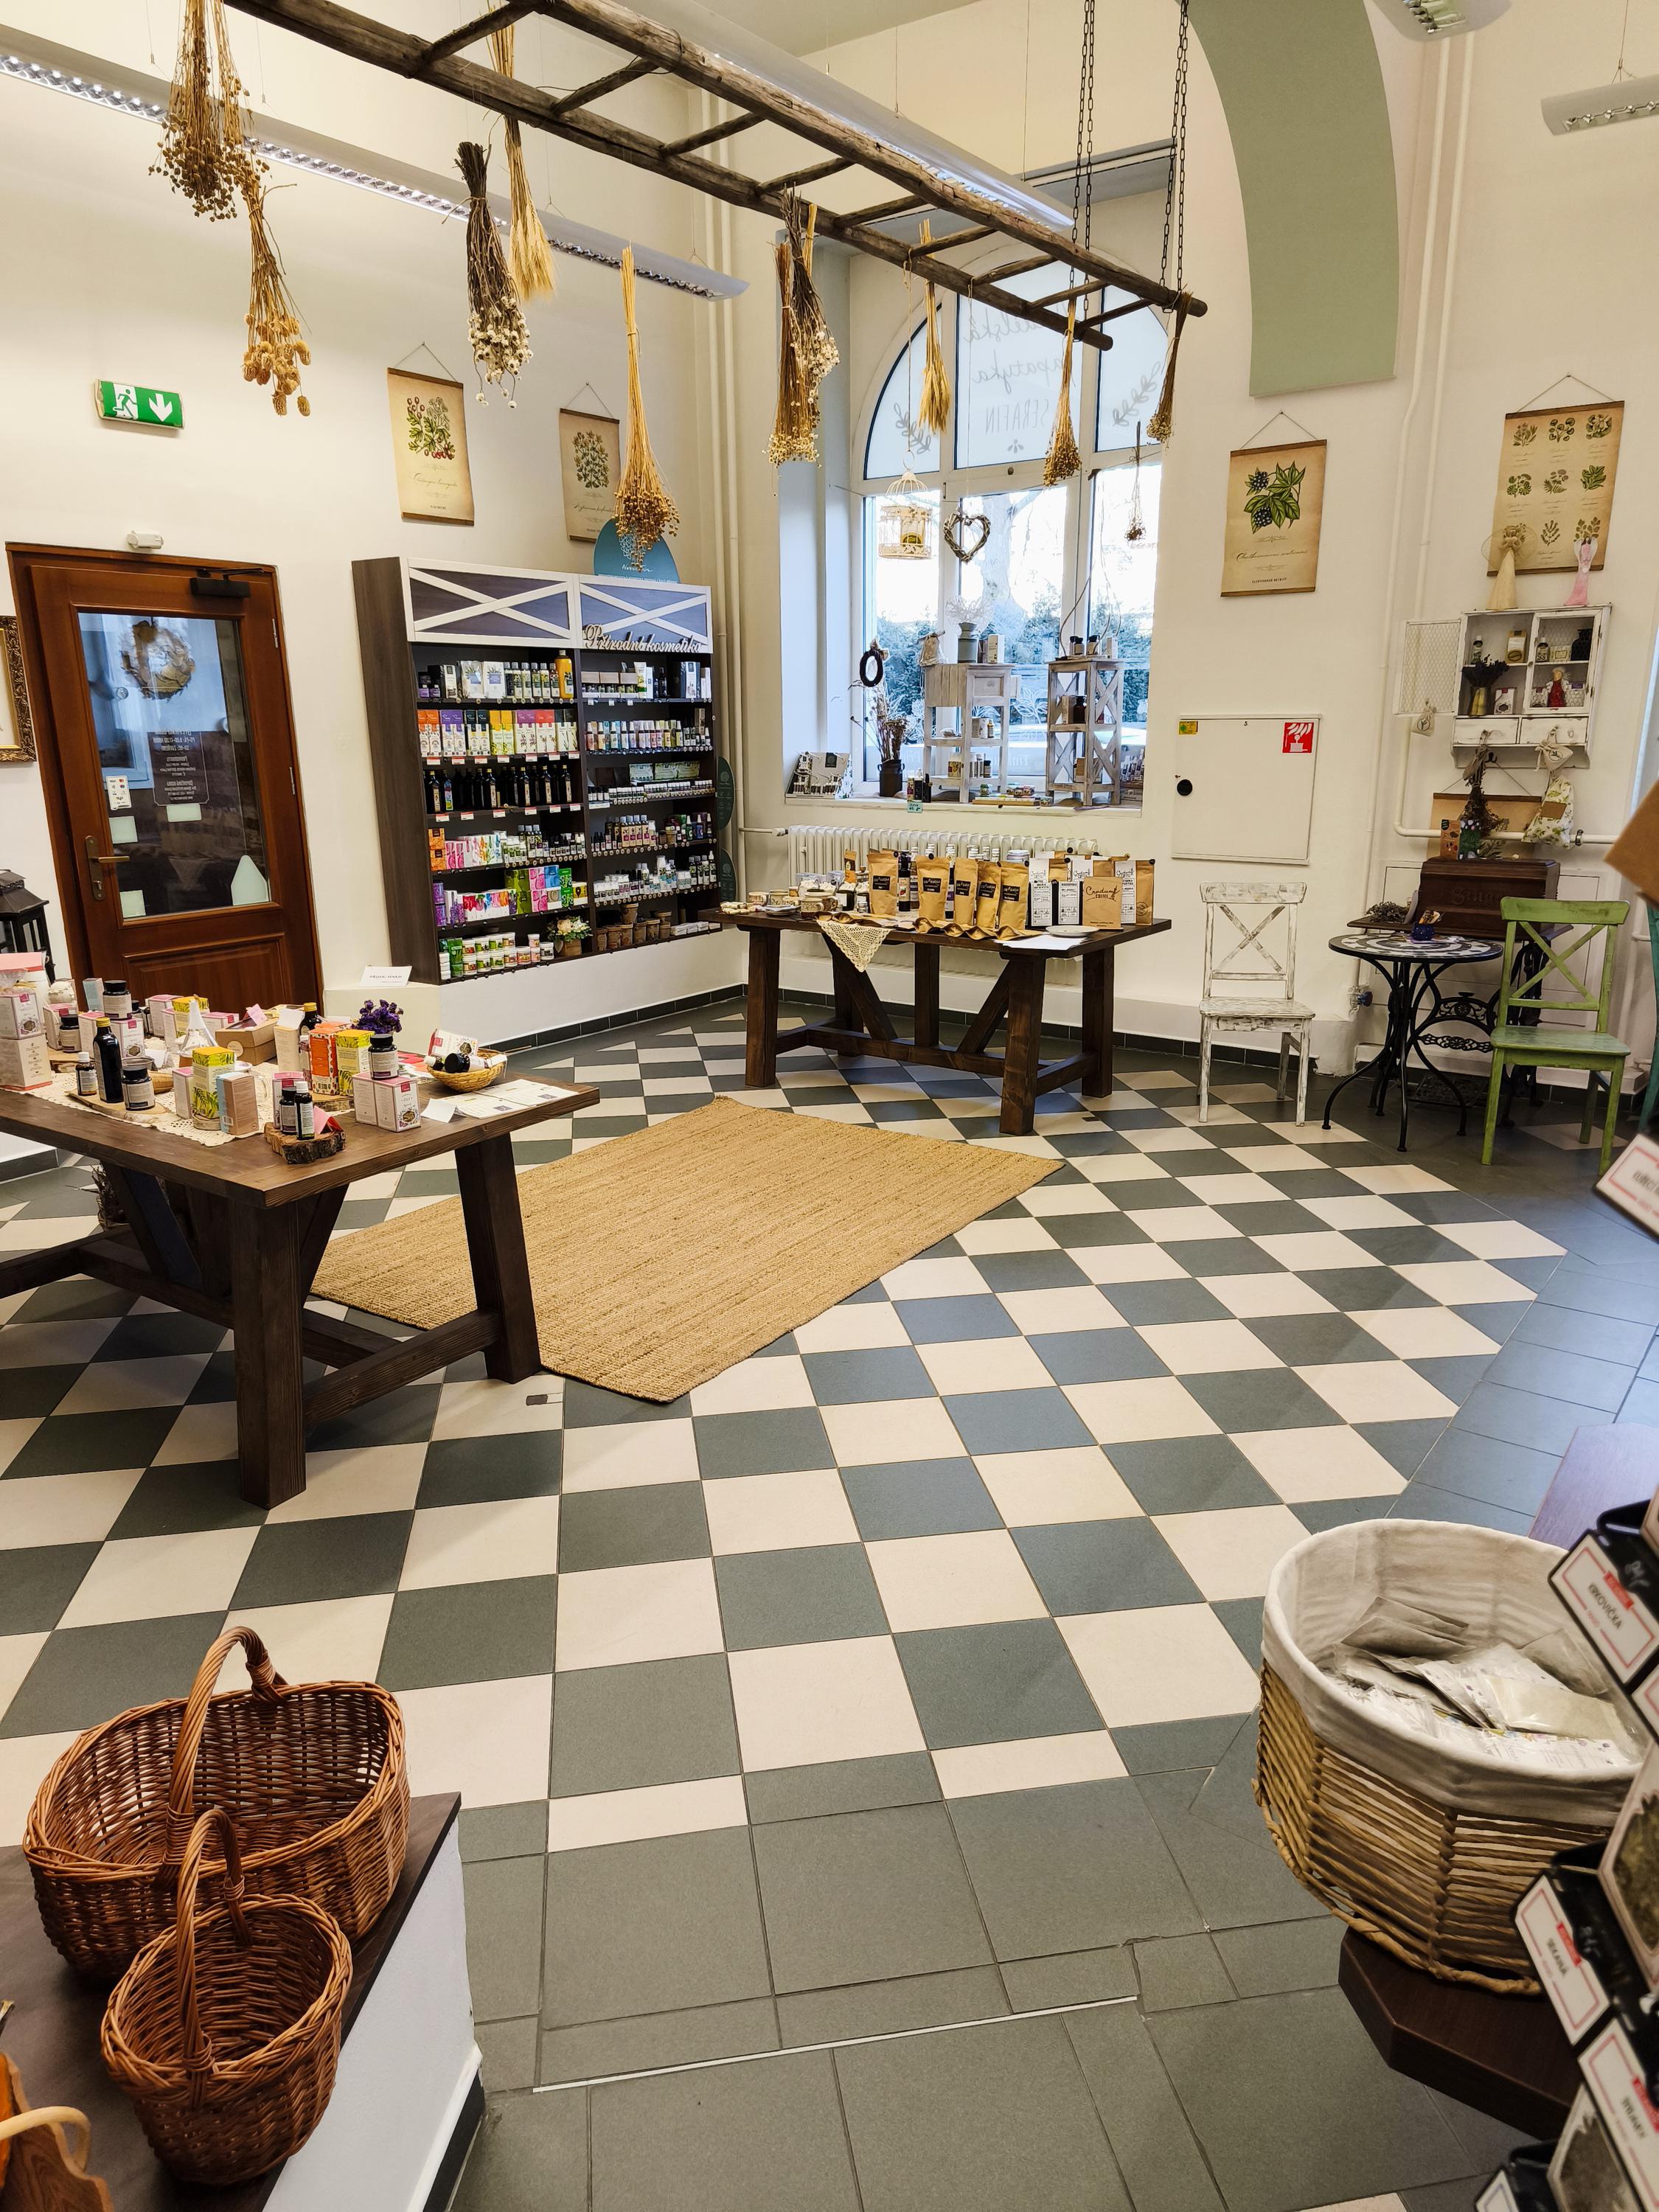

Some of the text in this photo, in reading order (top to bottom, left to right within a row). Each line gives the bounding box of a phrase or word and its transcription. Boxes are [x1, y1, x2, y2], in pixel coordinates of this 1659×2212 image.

[582, 624, 703, 654] Přírodní kosmetika
[1587, 1582, 1622, 1630] KRKOVIČKA
